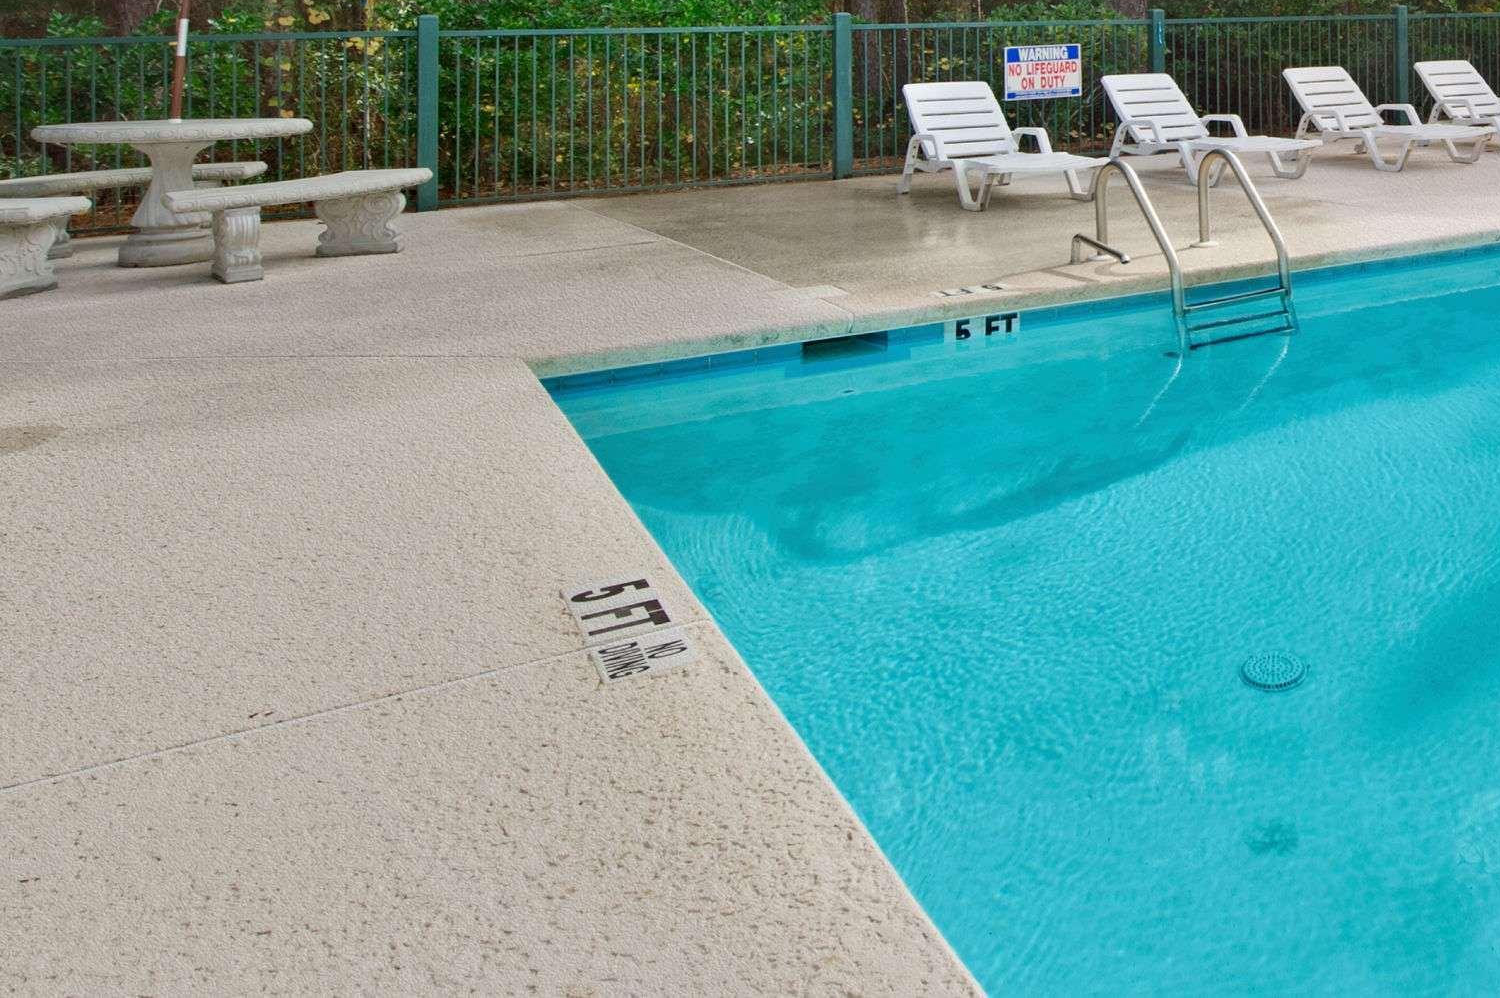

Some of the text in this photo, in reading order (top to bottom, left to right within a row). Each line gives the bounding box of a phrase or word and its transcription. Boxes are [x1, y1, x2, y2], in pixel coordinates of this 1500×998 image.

[1018, 46, 1068, 61] WARNING
[1008, 61, 1078, 76] NO LIFEGUARD
[1021, 76, 1065, 89] ON DUTY
[956, 312, 1018, 340] 5 FT
[571, 578, 671, 636] 5 FT
[644, 639, 687, 659] NO
[598, 641, 650, 679] DIVING
